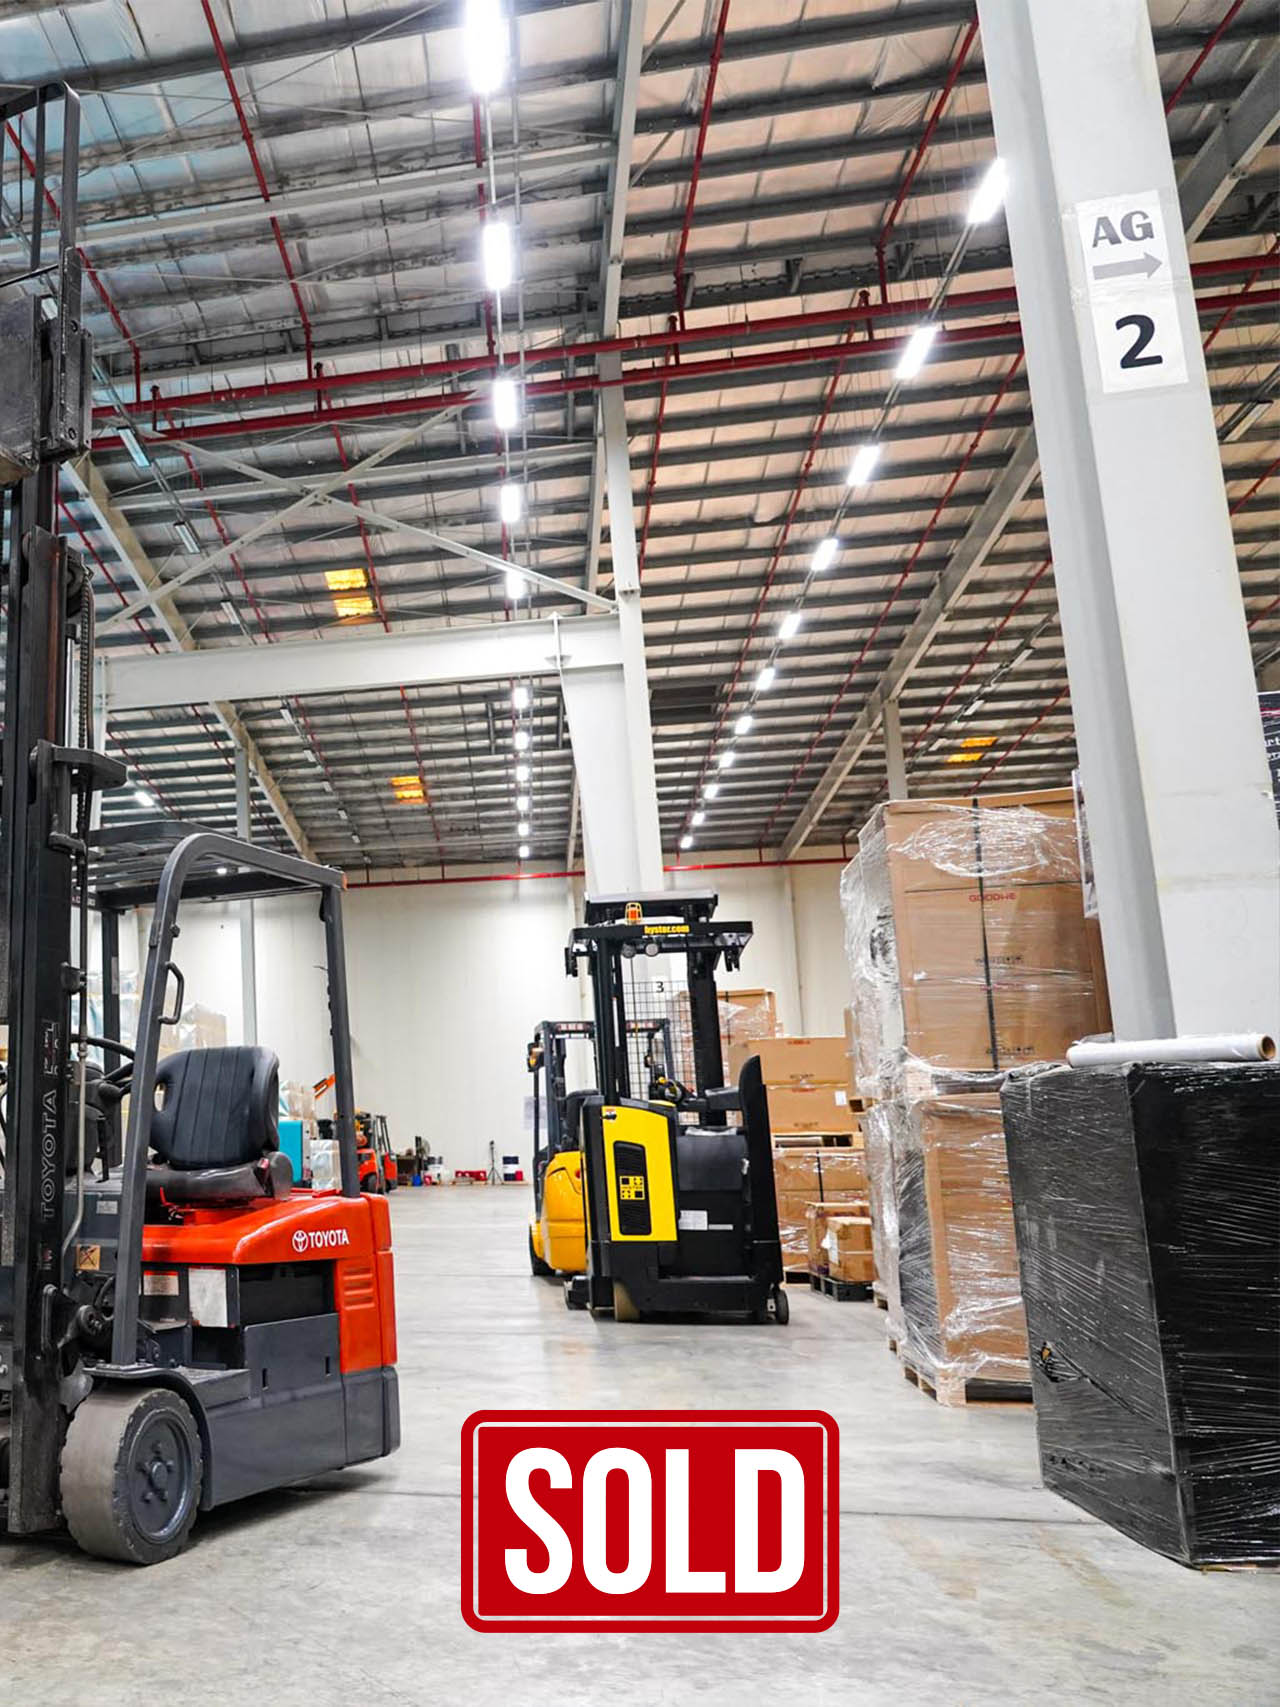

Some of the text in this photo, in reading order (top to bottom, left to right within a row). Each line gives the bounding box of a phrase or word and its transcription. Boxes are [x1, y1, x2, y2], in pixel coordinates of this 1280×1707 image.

[1092, 210, 1154, 248] AG
[1115, 314, 1163, 369] 2
[655, 981, 665, 993] 3
[40, 1089, 58, 1222] TOYOTA
[308, 1229, 350, 1248] TOYOTA
